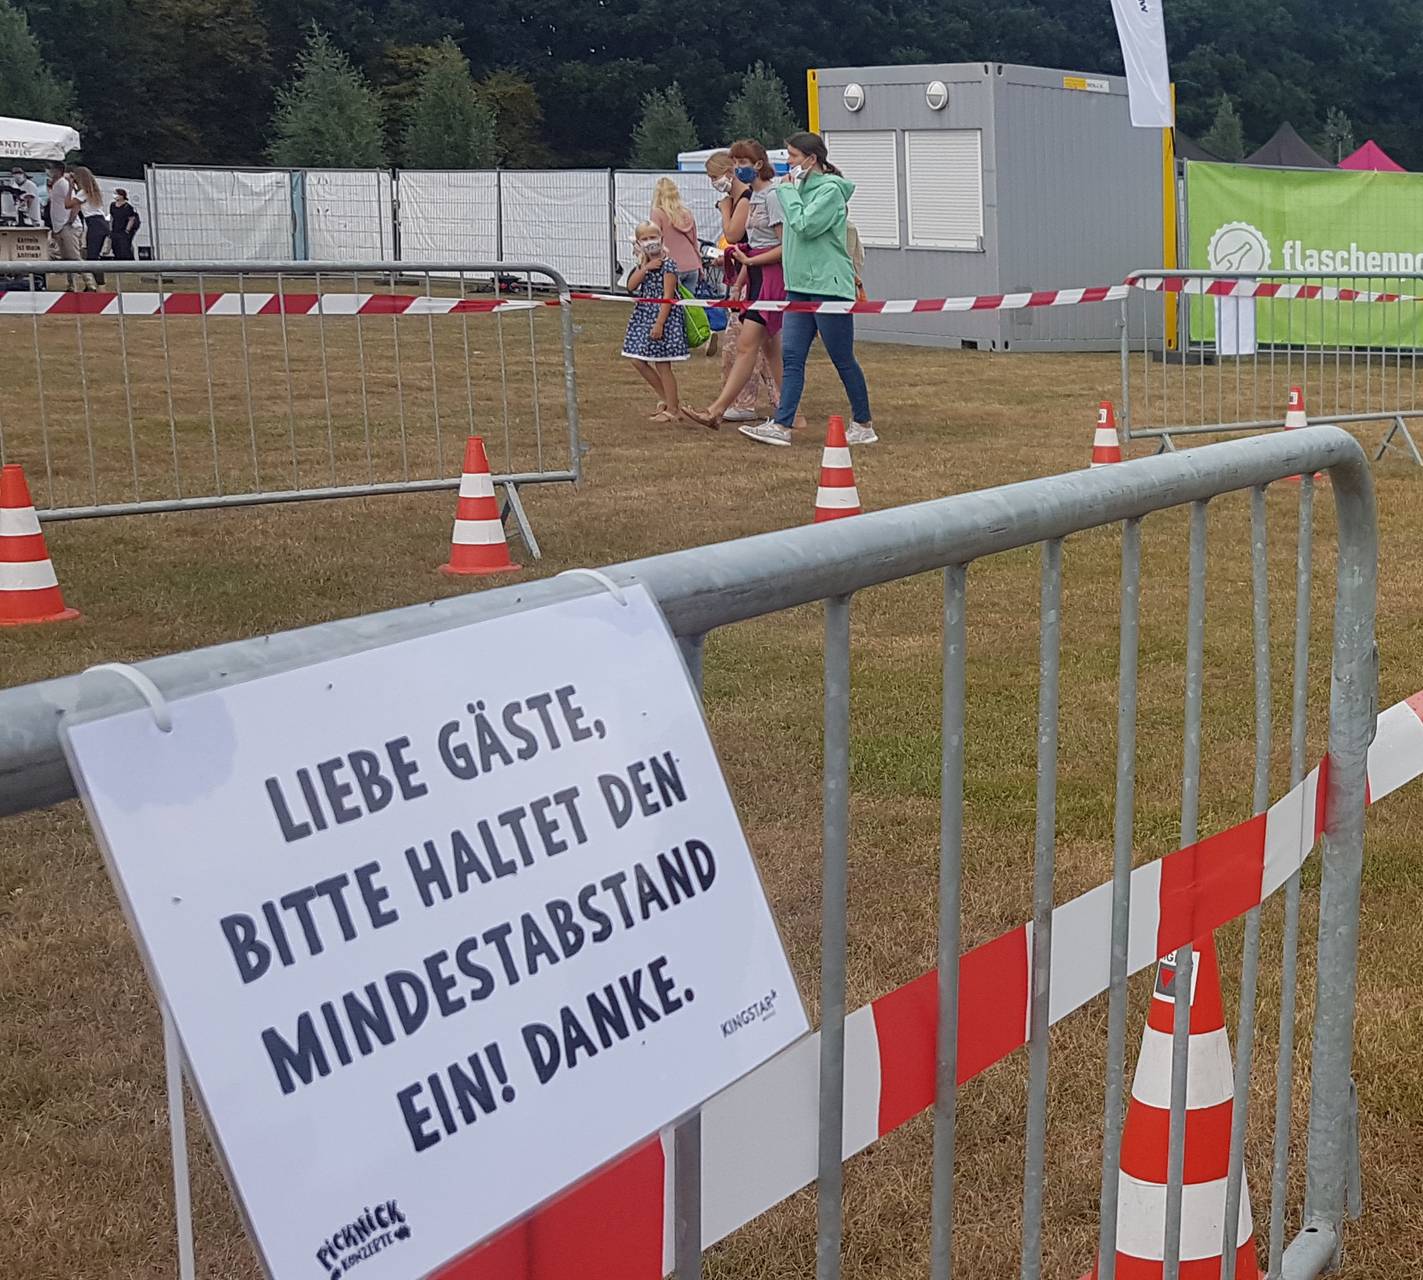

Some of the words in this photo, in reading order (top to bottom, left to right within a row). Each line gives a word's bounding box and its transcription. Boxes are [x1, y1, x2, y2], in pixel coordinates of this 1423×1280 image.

[265, 735, 428, 843] LIEBE
[437, 684, 606, 780] GÄSTE,
[220, 860, 400, 984] BITTE
[404, 786, 588, 907] HALTET
[597, 750, 688, 829] DEN
[261, 838, 717, 1095] MINDESTABSTAND
[396, 1041, 517, 1152] EIN!
[520, 955, 696, 1084] DANKE.
[720, 994, 775, 1038] KINGSTAR
[341, 1231, 396, 1271] KONZERTE
